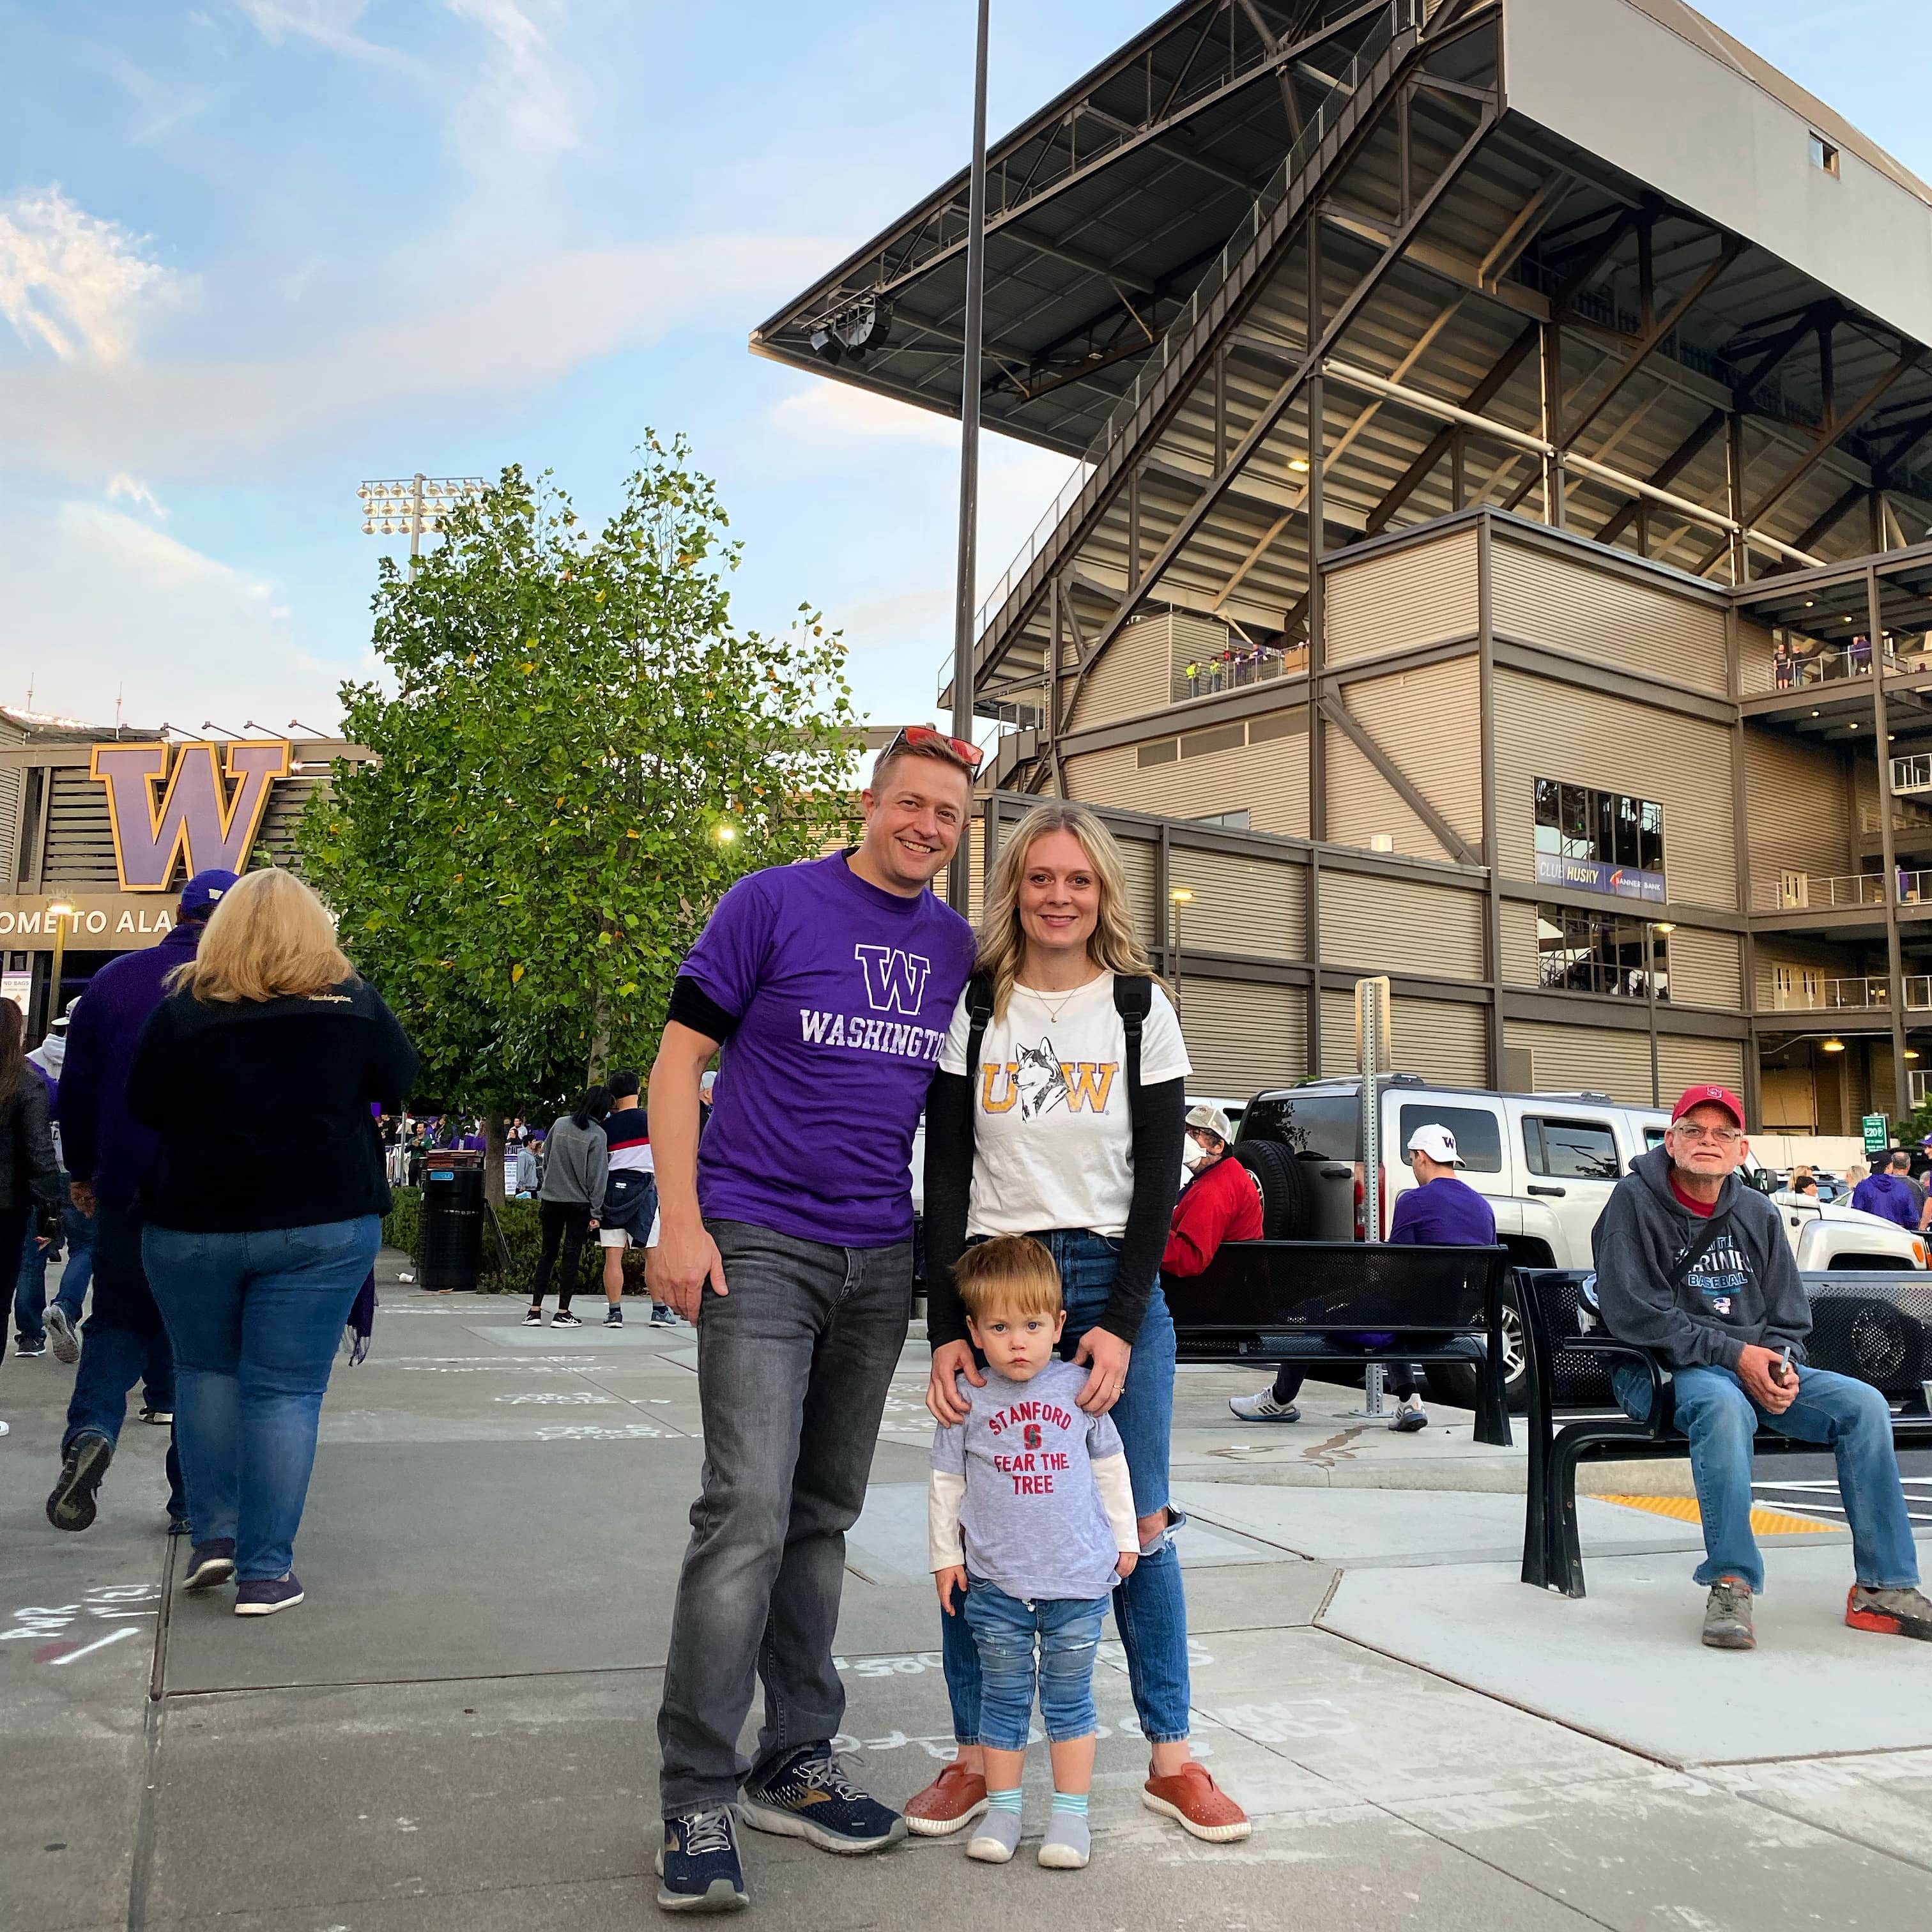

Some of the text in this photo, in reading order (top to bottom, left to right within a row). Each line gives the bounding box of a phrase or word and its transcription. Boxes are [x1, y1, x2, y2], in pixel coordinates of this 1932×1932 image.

[89, 740, 293, 892] W
[1540, 861, 1599, 885] CLUB HUSKY
[1644, 881, 1662, 891] BANK
[70, 910, 107, 934] TO
[115, 910, 173, 933] ALA
[854, 943, 931, 1016] W
[800, 1009, 946, 1062] WASHINGTO
[1441, 1136, 1455, 1149] W
[1864, 1127, 1878, 1137] E20
[1687, 1272, 1749, 1289] BASEBAL
[988, 1401, 1072, 1436] STANFORD
[994, 1453, 1070, 1473] FEAR THE
[1013, 1475, 1054, 1495] TREE
